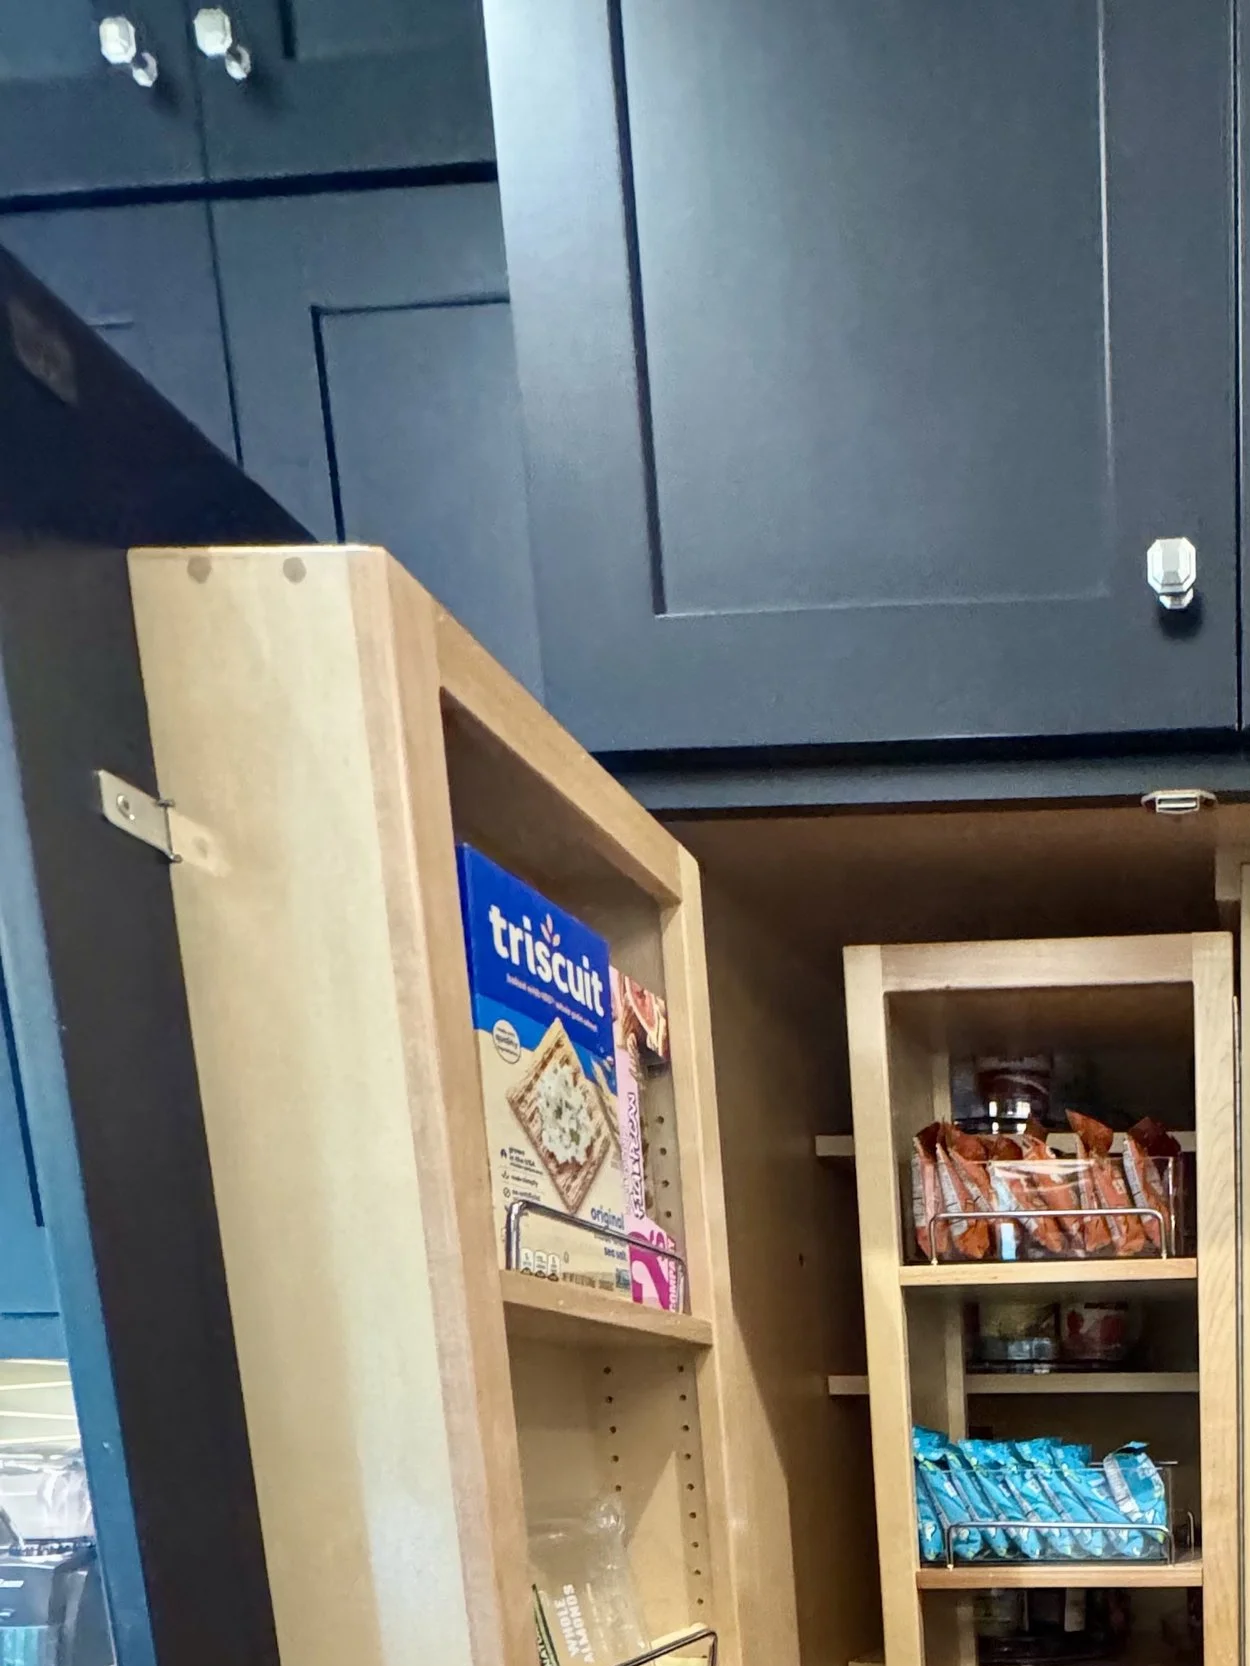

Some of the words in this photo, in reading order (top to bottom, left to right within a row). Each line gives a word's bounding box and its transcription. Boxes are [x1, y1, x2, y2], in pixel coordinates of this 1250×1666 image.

[489, 904, 604, 1017] triscuit
[591, 1205, 625, 1230] original
[667, 1236, 676, 1312] COMPAY
[554, 1597, 580, 1657] WHOLE
[563, 1584, 594, 1664] ALMONDS
